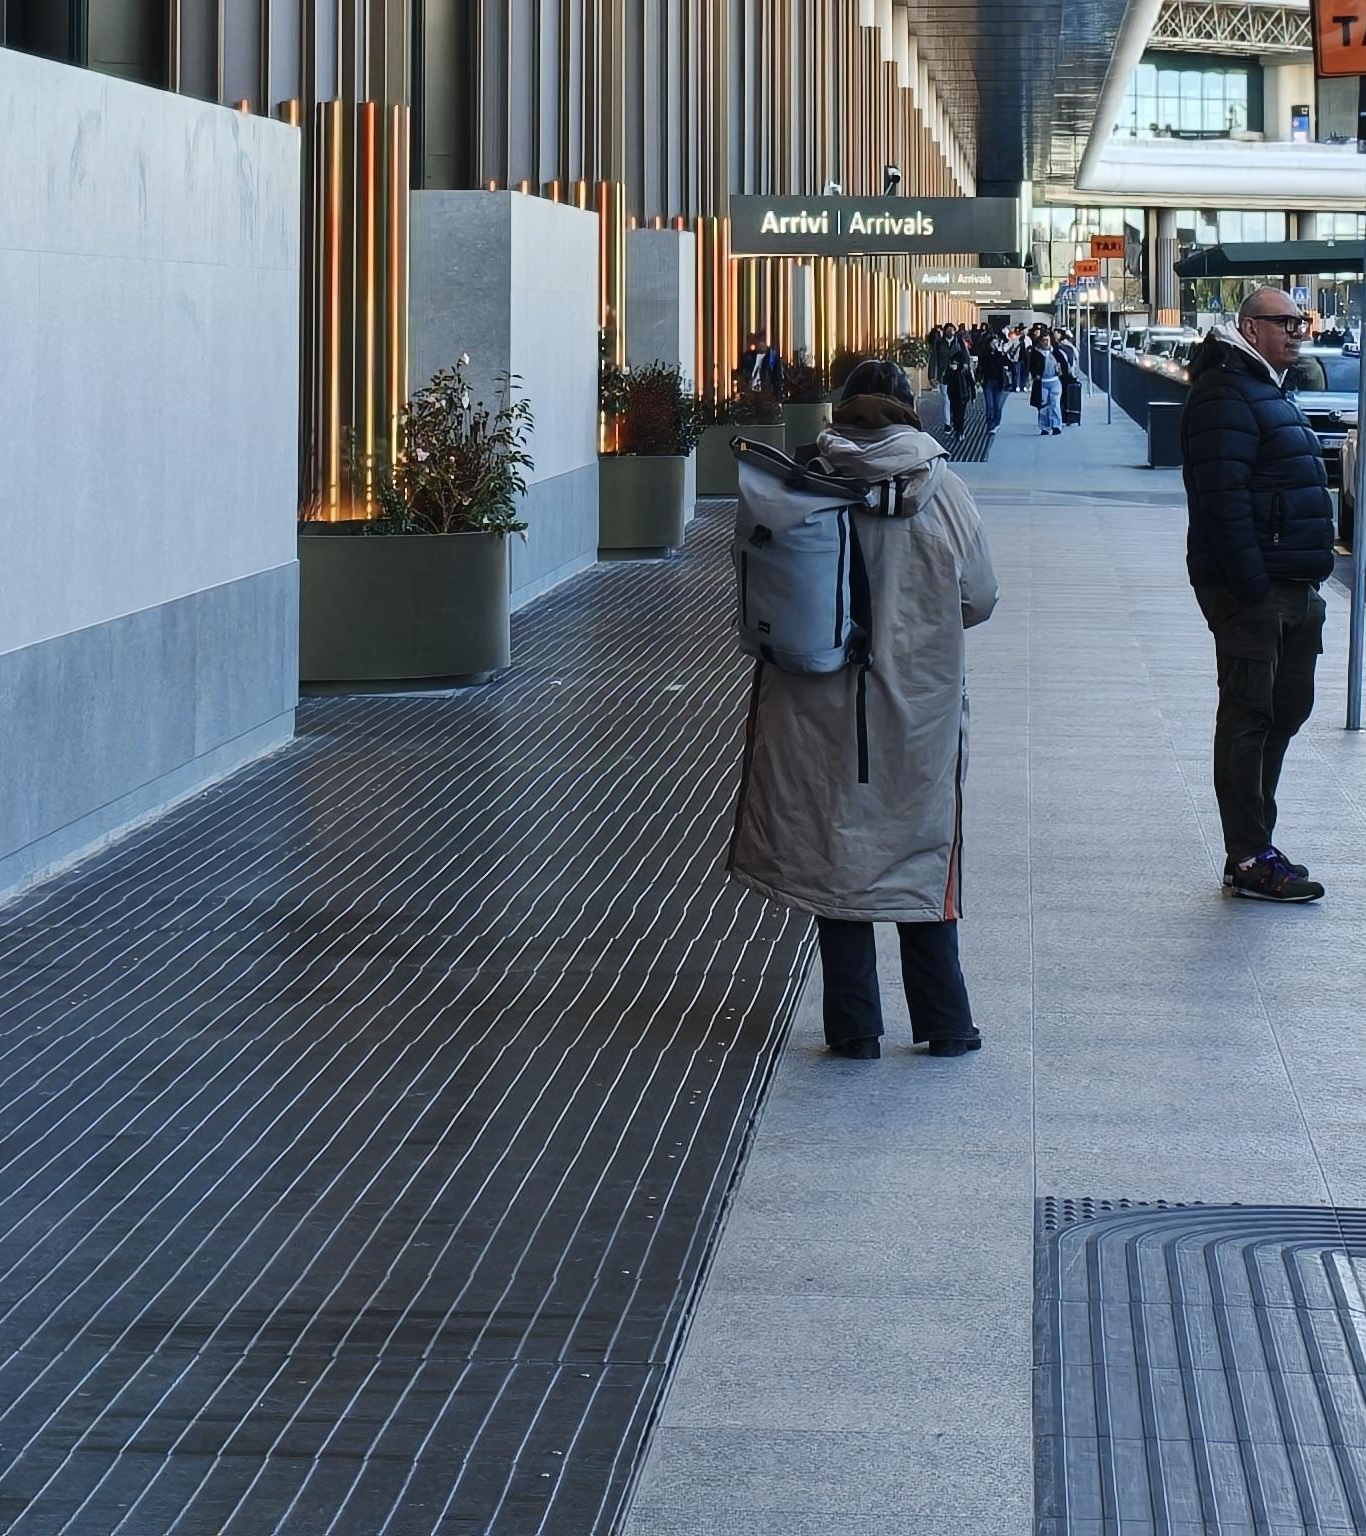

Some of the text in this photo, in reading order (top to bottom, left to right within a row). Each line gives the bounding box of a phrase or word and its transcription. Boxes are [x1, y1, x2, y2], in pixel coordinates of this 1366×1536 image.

[760, 210, 934, 236] Arrivi Arrivals
[957, 273, 992, 284] Arrivals
